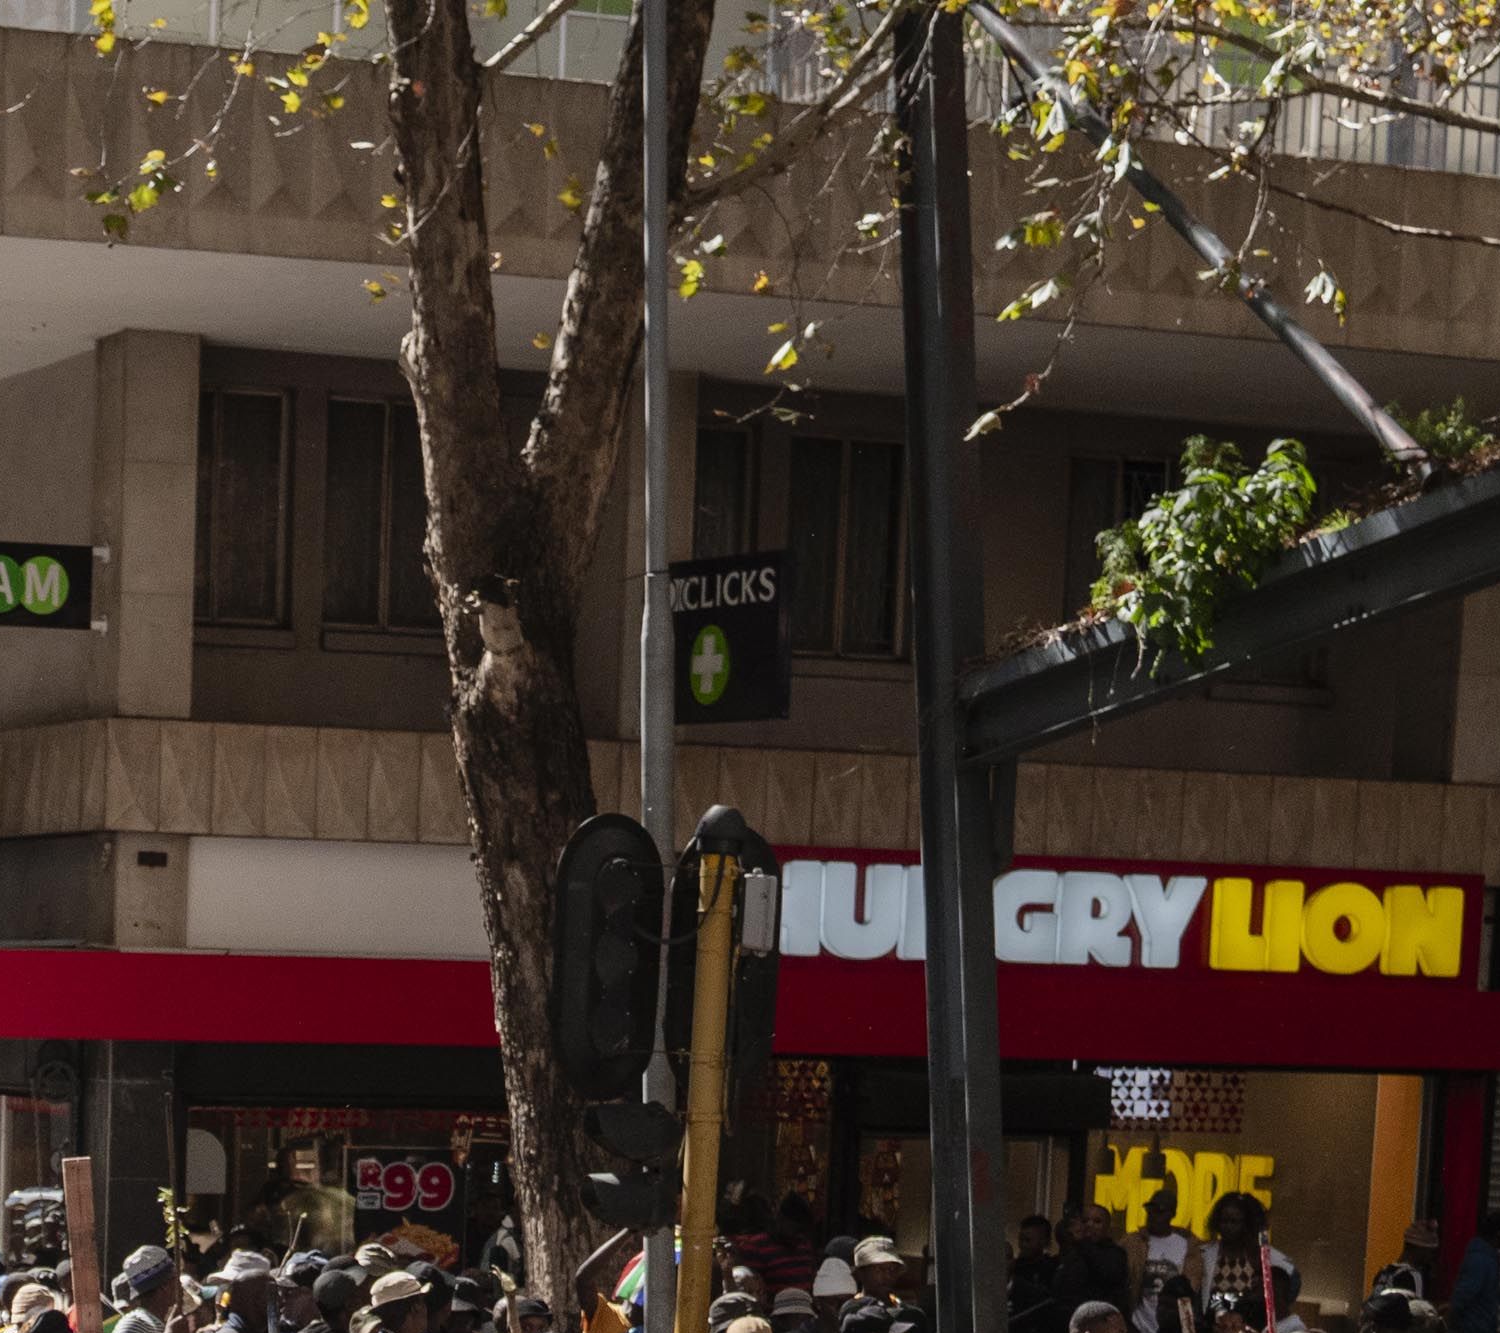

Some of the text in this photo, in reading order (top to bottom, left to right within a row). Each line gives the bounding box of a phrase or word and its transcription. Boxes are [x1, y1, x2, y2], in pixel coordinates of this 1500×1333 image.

[684, 567, 777, 610] CLICKS
[781, 860, 1465, 978] HUGRY LION
